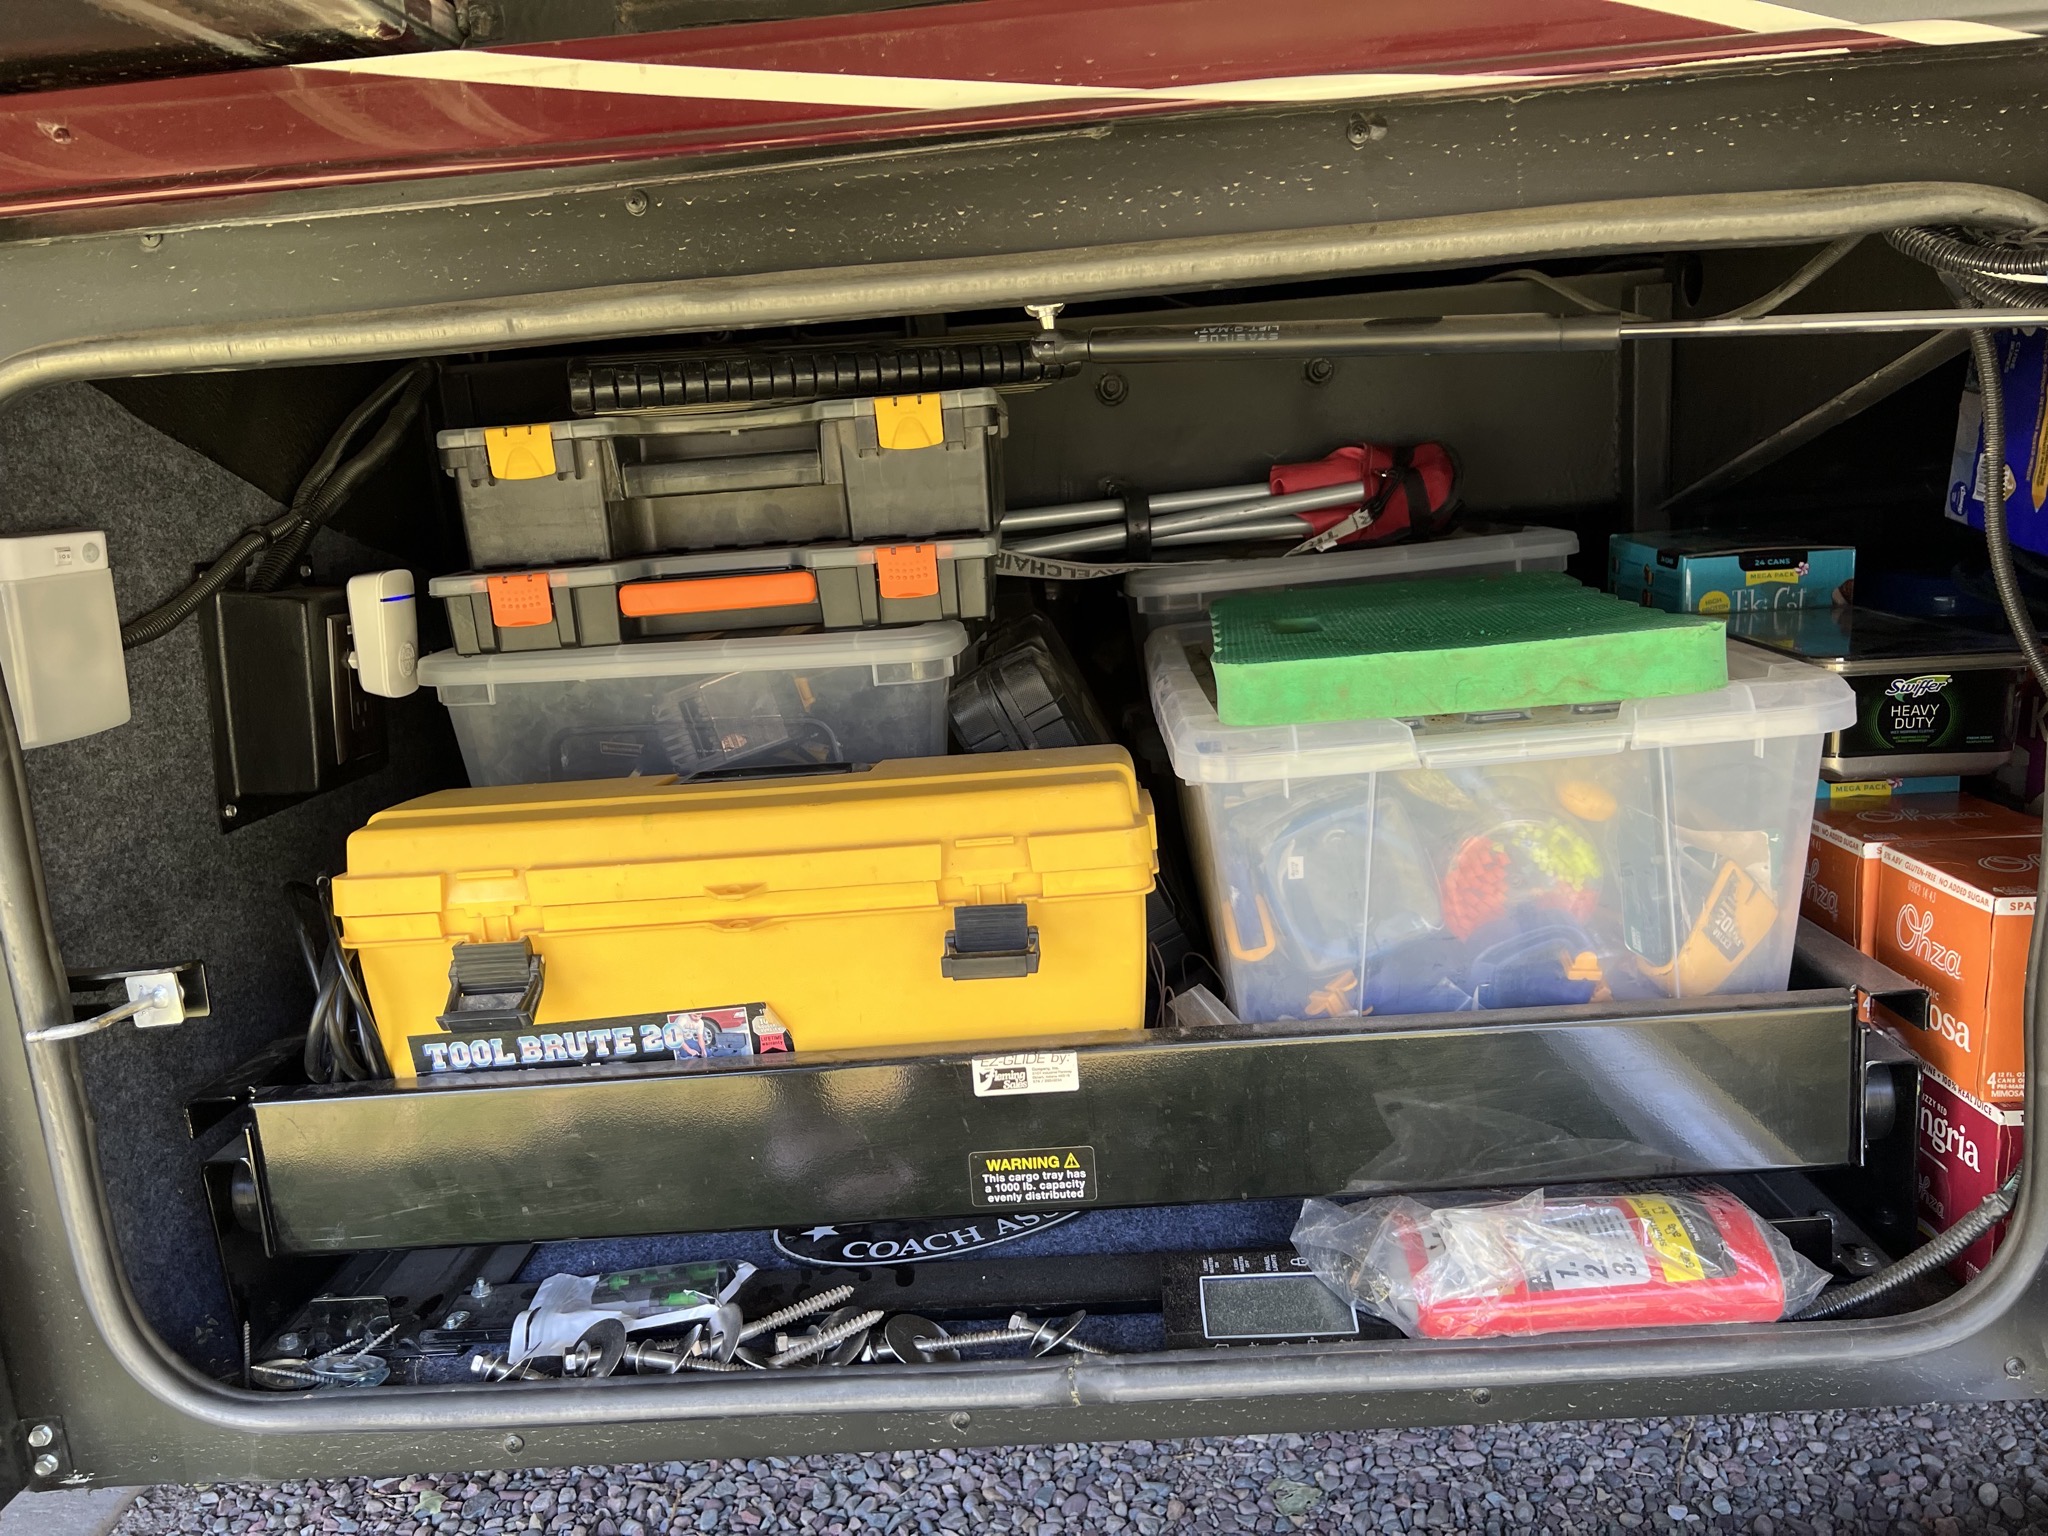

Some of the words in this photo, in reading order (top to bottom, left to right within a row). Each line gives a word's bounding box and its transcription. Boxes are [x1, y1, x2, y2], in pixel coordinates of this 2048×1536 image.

[1199, 332, 1279, 342] STABILUS
[1767, 558, 1791, 566] CANS
[1774, 571, 1795, 579] PACK
[1885, 677, 1948, 698] Swiffer
[1891, 704, 1940, 717] HEAVY
[1894, 716, 1935, 730] DUTY
[1835, 784, 1861, 792] MEGA
[1863, 783, 1887, 791] PACK
[1939, 876, 1948, 888] NO
[1949, 880, 1967, 897] ADDED
[1967, 891, 1990, 907] SUGAR
[1896, 903, 1963, 980] Ohza
[1930, 1004, 1971, 1053] osa
[422, 1038, 517, 1071] TOOL
[517, 1027, 638, 1063] BRUTE
[639, 1022, 686, 1052] 20
[1003, 1079, 1028, 1089] Sales
[1987, 1072, 1996, 1089] 4
[1922, 1093, 1937, 1107] IZZY
[1937, 1103, 1948, 1116] RED
[1973, 1098, 1993, 1117] JUICE
[1920, 1106, 1981, 1173] ngria
[985, 1156, 1060, 1171] WARNING
[982, 1174, 1005, 1183] This
[1008, 1172, 1039, 1183] cargo
[1042, 1170, 1064, 1181] tray
[1066, 1170, 1087, 1179] has
[985, 1185, 992, 1193] a
[995, 1183, 1020, 1192] 1000
[1022, 1182, 1037, 1191] lb.
[1039, 1180, 1086, 1192] capacity
[988, 1193, 1022, 1203] evenly
[1025, 1189, 1085, 1201] distributed
[842, 1226, 985, 1258] COACH
